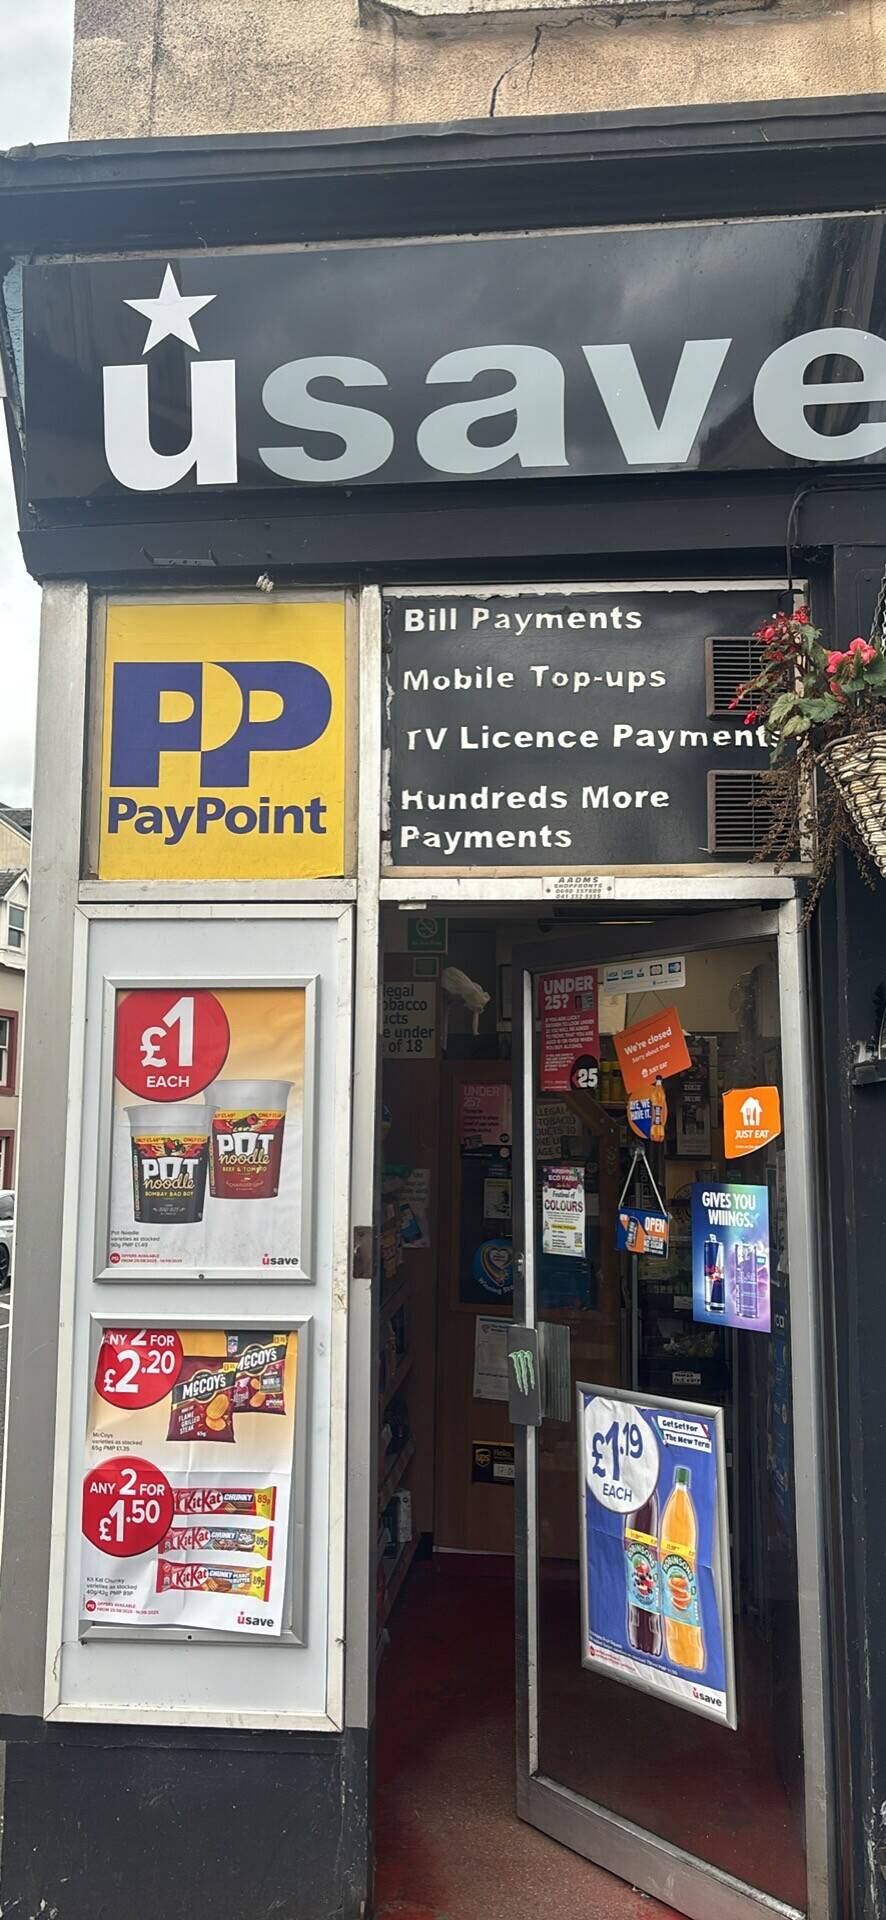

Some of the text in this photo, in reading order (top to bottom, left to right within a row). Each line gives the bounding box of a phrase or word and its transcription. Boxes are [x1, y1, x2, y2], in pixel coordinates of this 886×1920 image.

[103, 327, 886, 491] usave
[404, 605, 643, 635] Bill Payments
[403, 665, 667, 693] Mobile Top-ups
[110, 661, 332, 787] PP
[407, 724, 782, 753] TV Licence Payments
[401, 786, 670, 810] Hundreds More
[107, 796, 327, 845] PayPoint
[401, 825, 573, 854] Payments
[543, 976, 594, 994] UNDER
[544, 994, 569, 1010] 25?
[140, 996, 195, 1068] £1
[395, 1025, 434, 1038] under
[624, 1026, 673, 1056] We're closed
[388, 1039, 423, 1052] of 18
[631, 1047, 660, 1064] Sorry about
[146, 1075, 190, 1088] EACH
[578, 1067, 598, 1088] 25
[216, 1132, 274, 1157] POT
[735, 1129, 770, 1139] JUST EAT
[219, 1147, 270, 1165] noodle
[141, 1156, 199, 1181] POT
[143, 1173, 195, 1190] noodle
[570, 1191, 576, 1199] of
[702, 1191, 757, 1211] GIVES YOU
[544, 1199, 584, 1213] COLOURS
[645, 1216, 665, 1233] OPEN
[262, 1254, 299, 1265] usave
[131, 1329, 147, 1346] 2
[150, 1335, 175, 1346] FOR
[103, 1349, 176, 1393] £2.20
[674, 1421, 686, 1430] Set
[686, 1424, 698, 1432] For
[592, 1421, 643, 1481] £1.19
[665, 1433, 711, 1448] The New Term
[89, 1468, 165, 1496] ANY 2 FOR
[602, 1483, 632, 1502] EACH
[185, 1490, 223, 1513] KitKat
[257, 1494, 271, 1505] 89p
[99, 1499, 160, 1542] £1.50
[176, 1528, 209, 1550] KitKat
[211, 1531, 236, 1539] CHUNKY
[628, 1543, 656, 1568] ROBINSONS
[176, 1566, 208, 1588] KitKat
[663, 1555, 693, 1580] ROBINSONS
[237, 1612, 274, 1627] usave
[693, 1687, 722, 1706] usave
